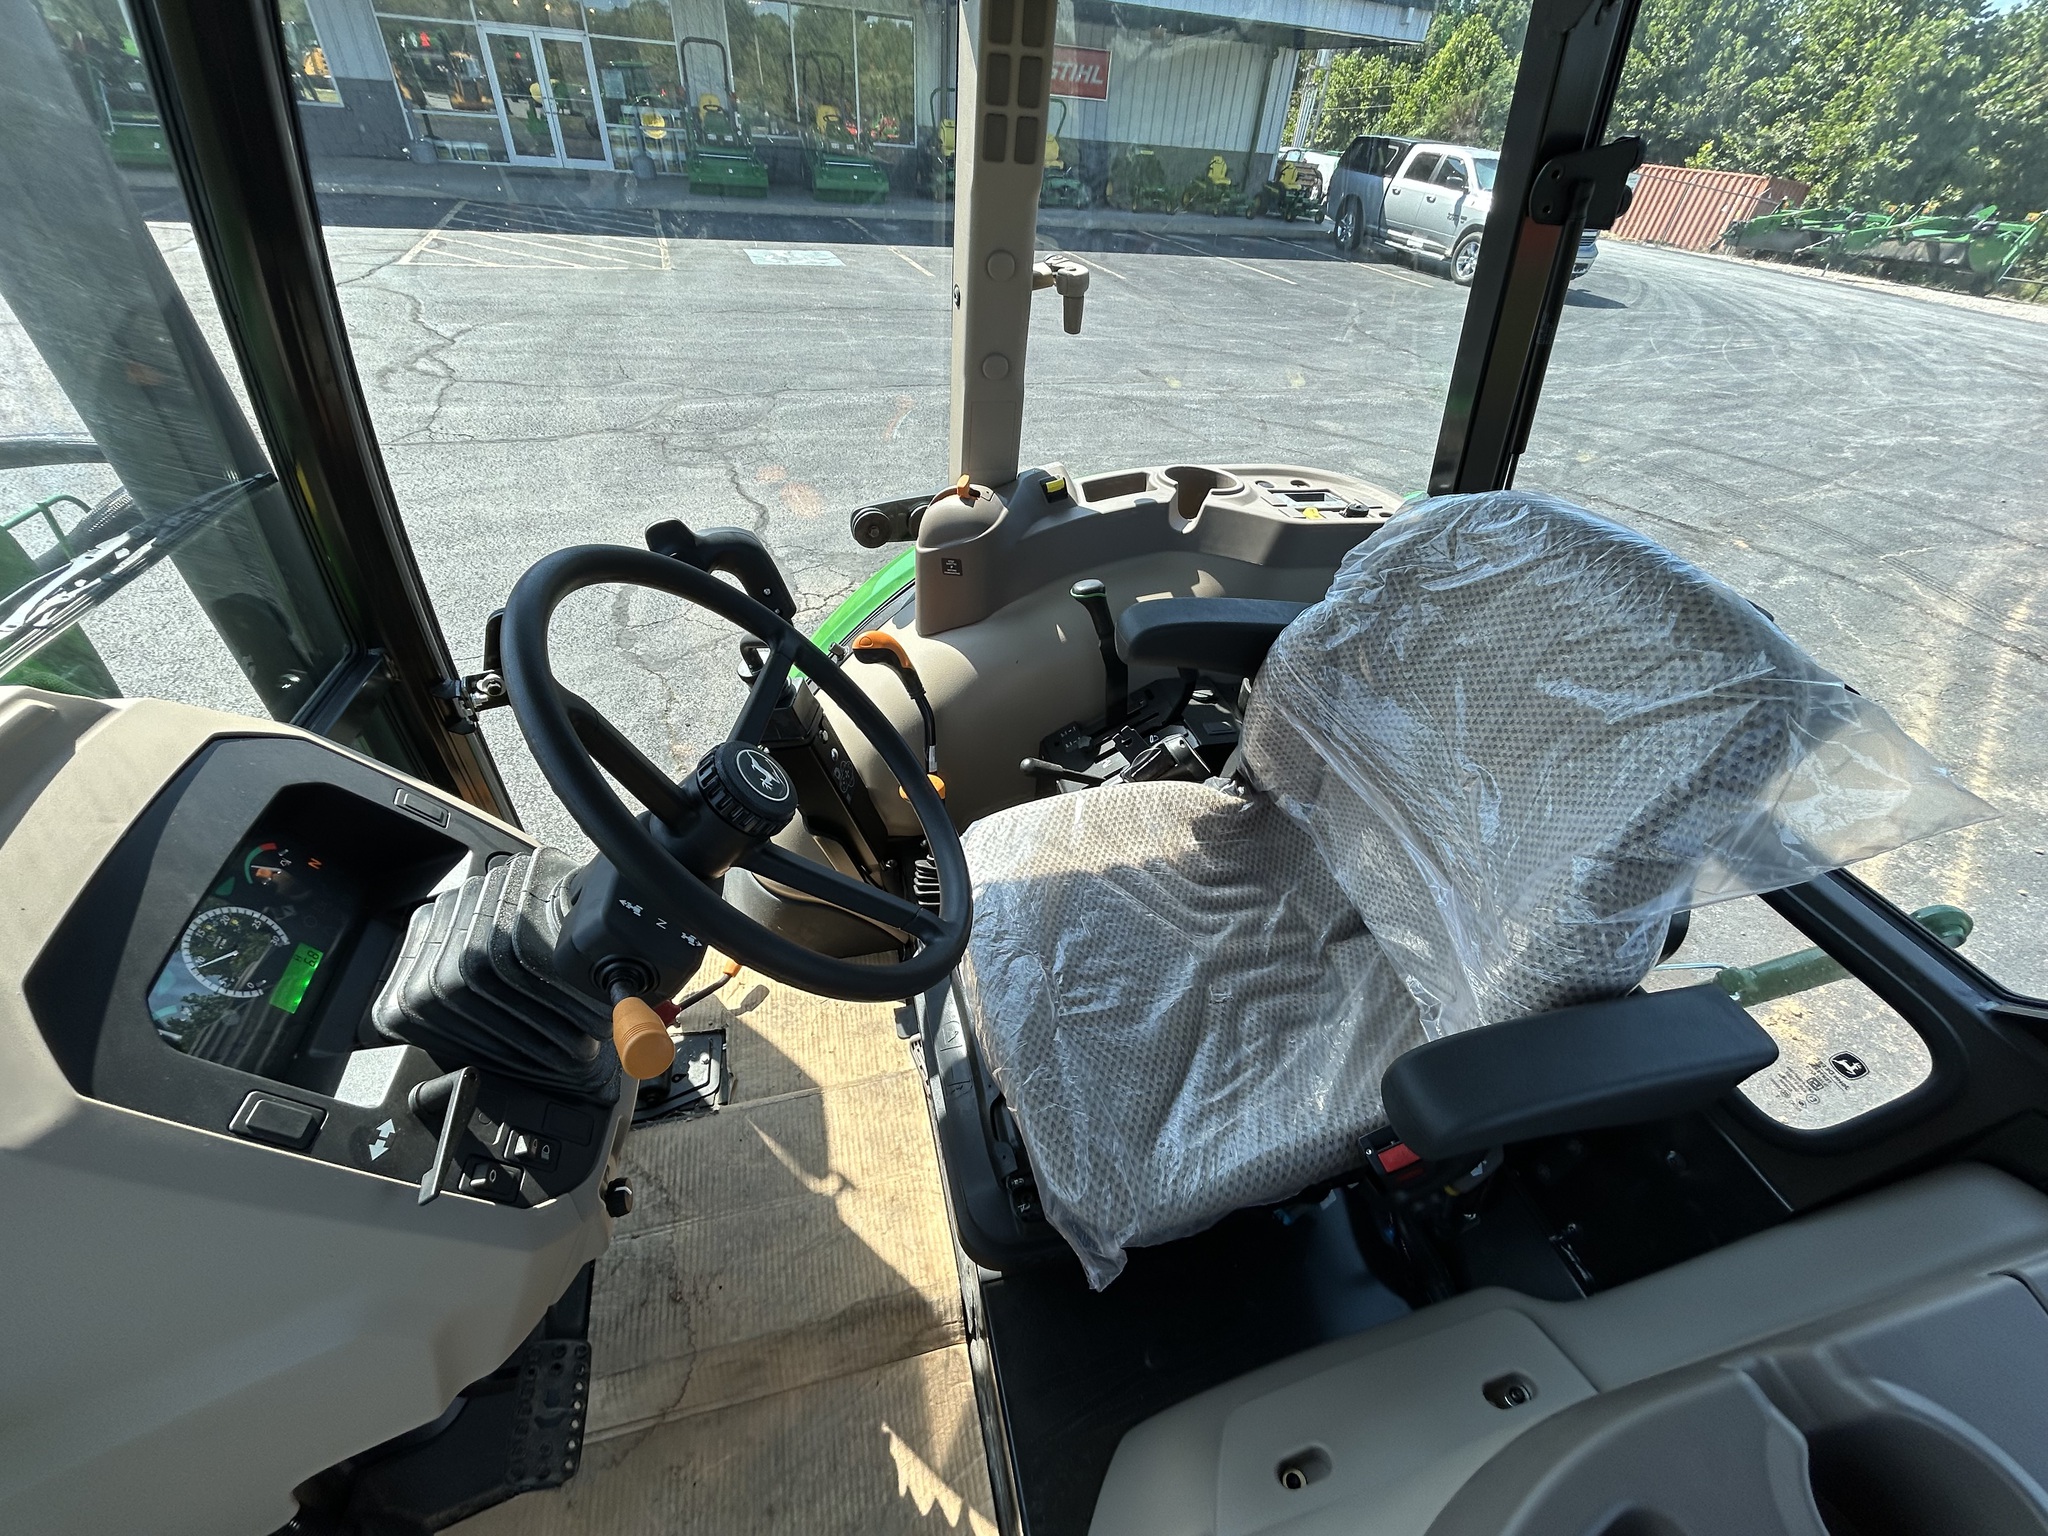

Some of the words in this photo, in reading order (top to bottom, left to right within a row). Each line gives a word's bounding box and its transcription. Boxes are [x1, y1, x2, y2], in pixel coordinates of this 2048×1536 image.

[220, 914, 231, 926] 20
[252, 919, 262, 930] 25
[655, 917, 668, 930] N
[195, 928, 206, 939] 15
[270, 935, 280, 946] 30
[195, 955, 206, 965] 10
[246, 981, 255, 989] 0
